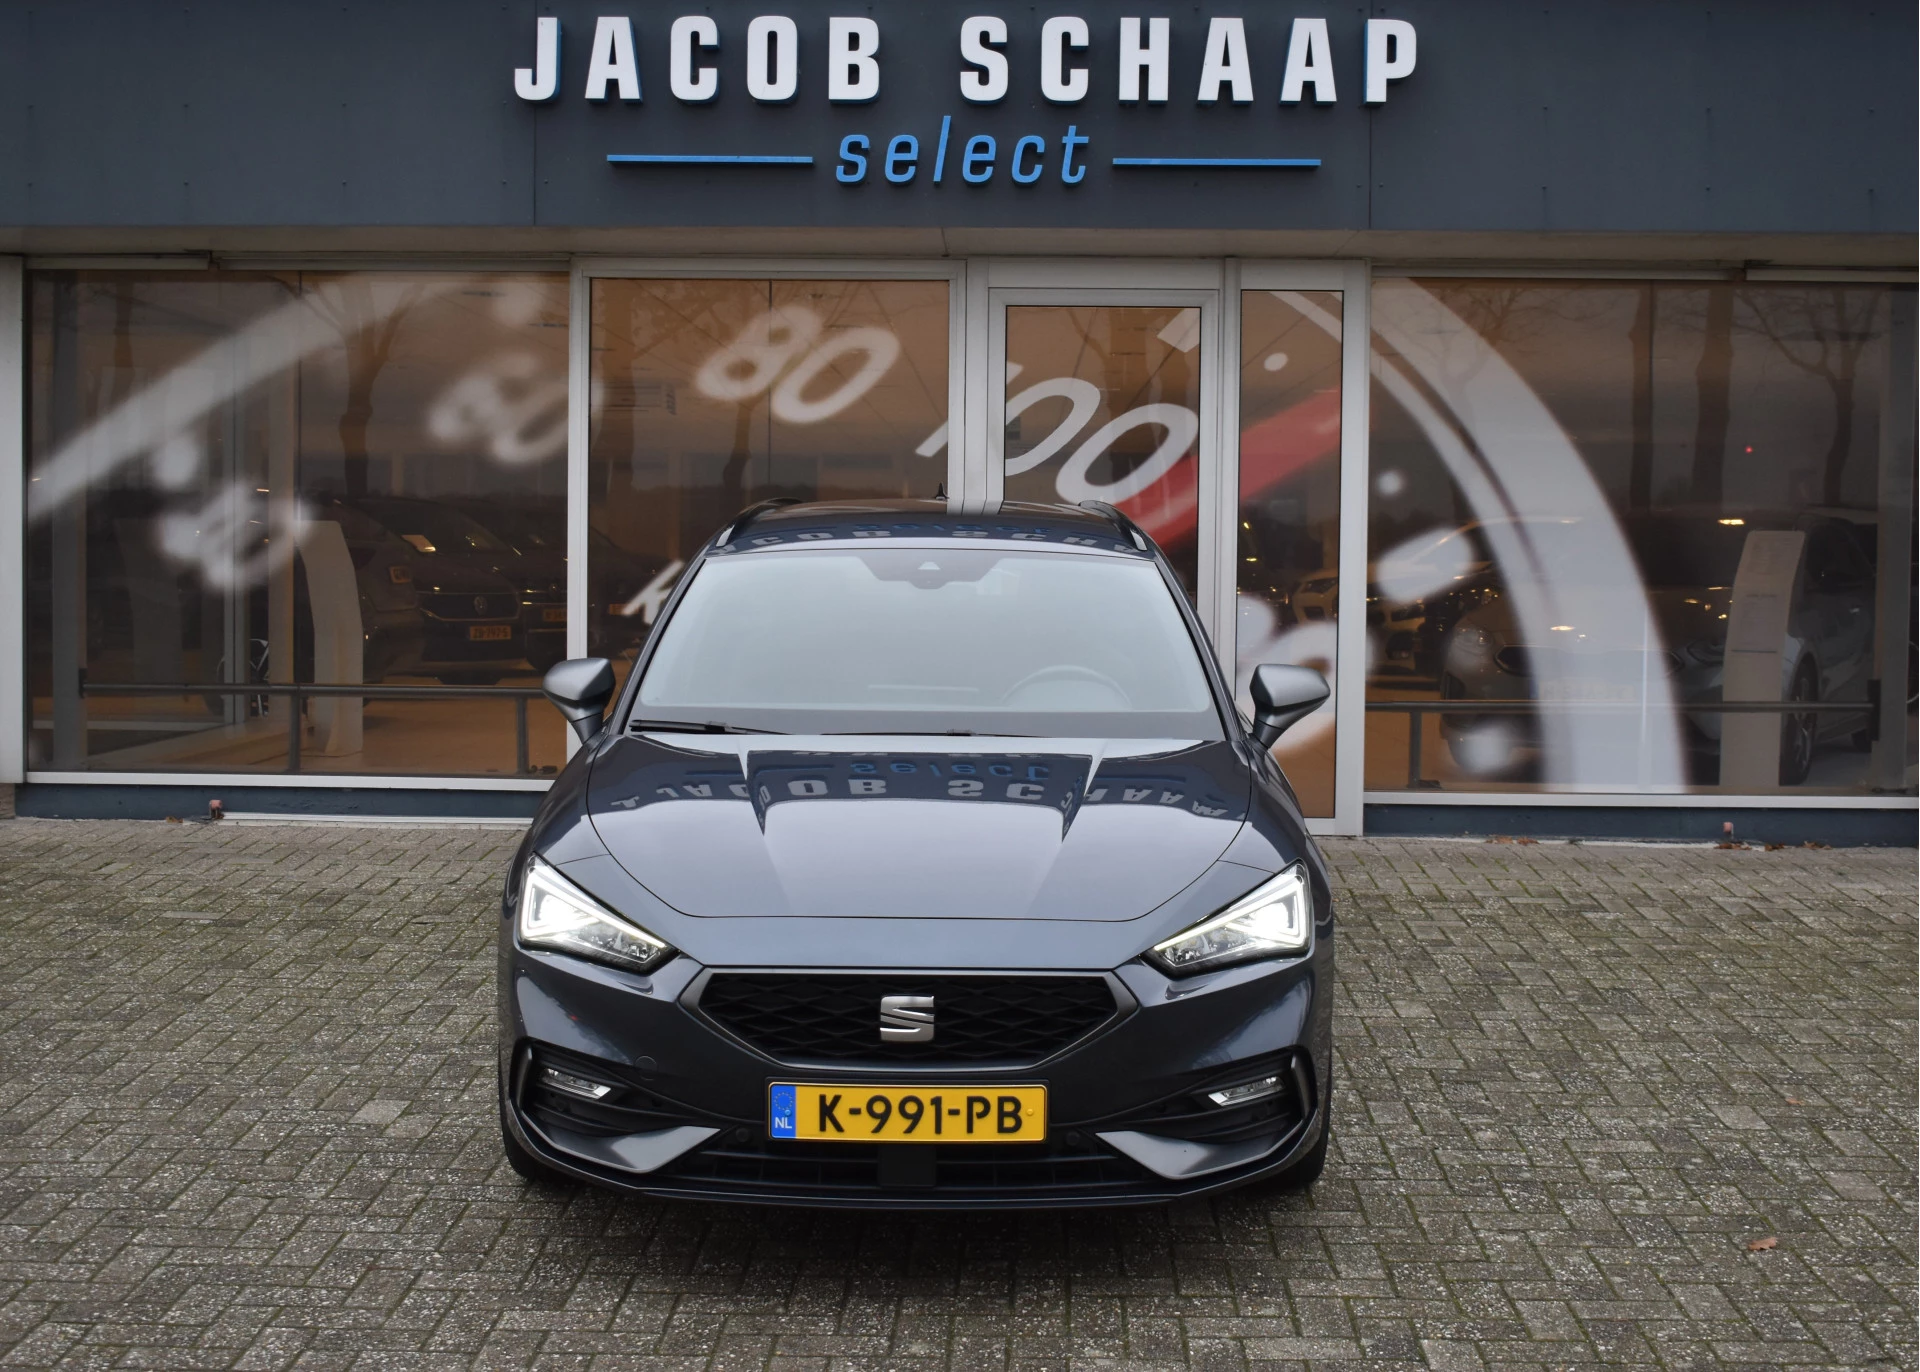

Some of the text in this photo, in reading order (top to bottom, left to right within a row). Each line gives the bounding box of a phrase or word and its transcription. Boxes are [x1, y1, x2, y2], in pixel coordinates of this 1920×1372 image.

[514, 15, 1418, 105] JACOB SCHAAP
[835, 115, 1091, 186] select
[696, 304, 900, 424] 80
[774, 1093, 1023, 1135] NL K-991-PB
